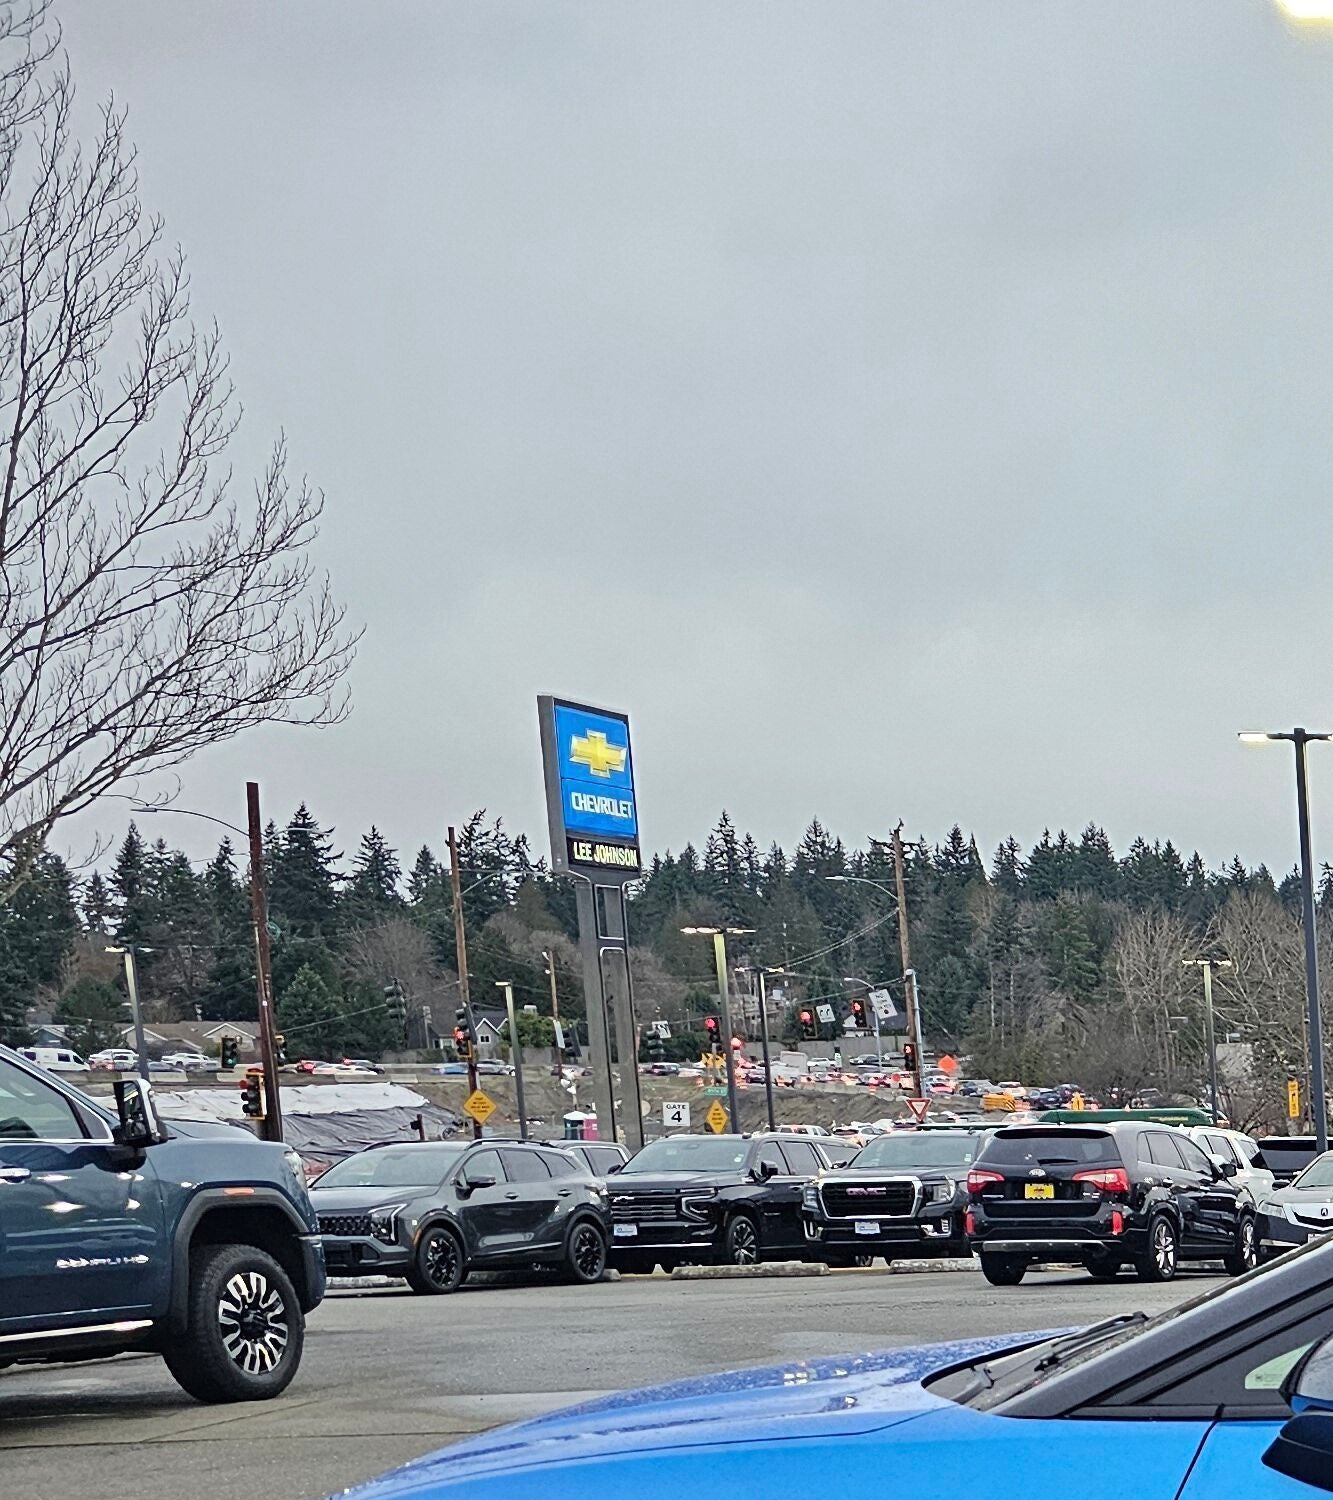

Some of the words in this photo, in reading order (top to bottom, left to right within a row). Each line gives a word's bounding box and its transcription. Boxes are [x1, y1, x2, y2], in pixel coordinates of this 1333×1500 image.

[571, 791, 633, 818] CHEVROLET
[573, 841, 593, 861] LEE
[594, 844, 638, 867] JOHNSON
[671, 1110, 682, 1122] 4
